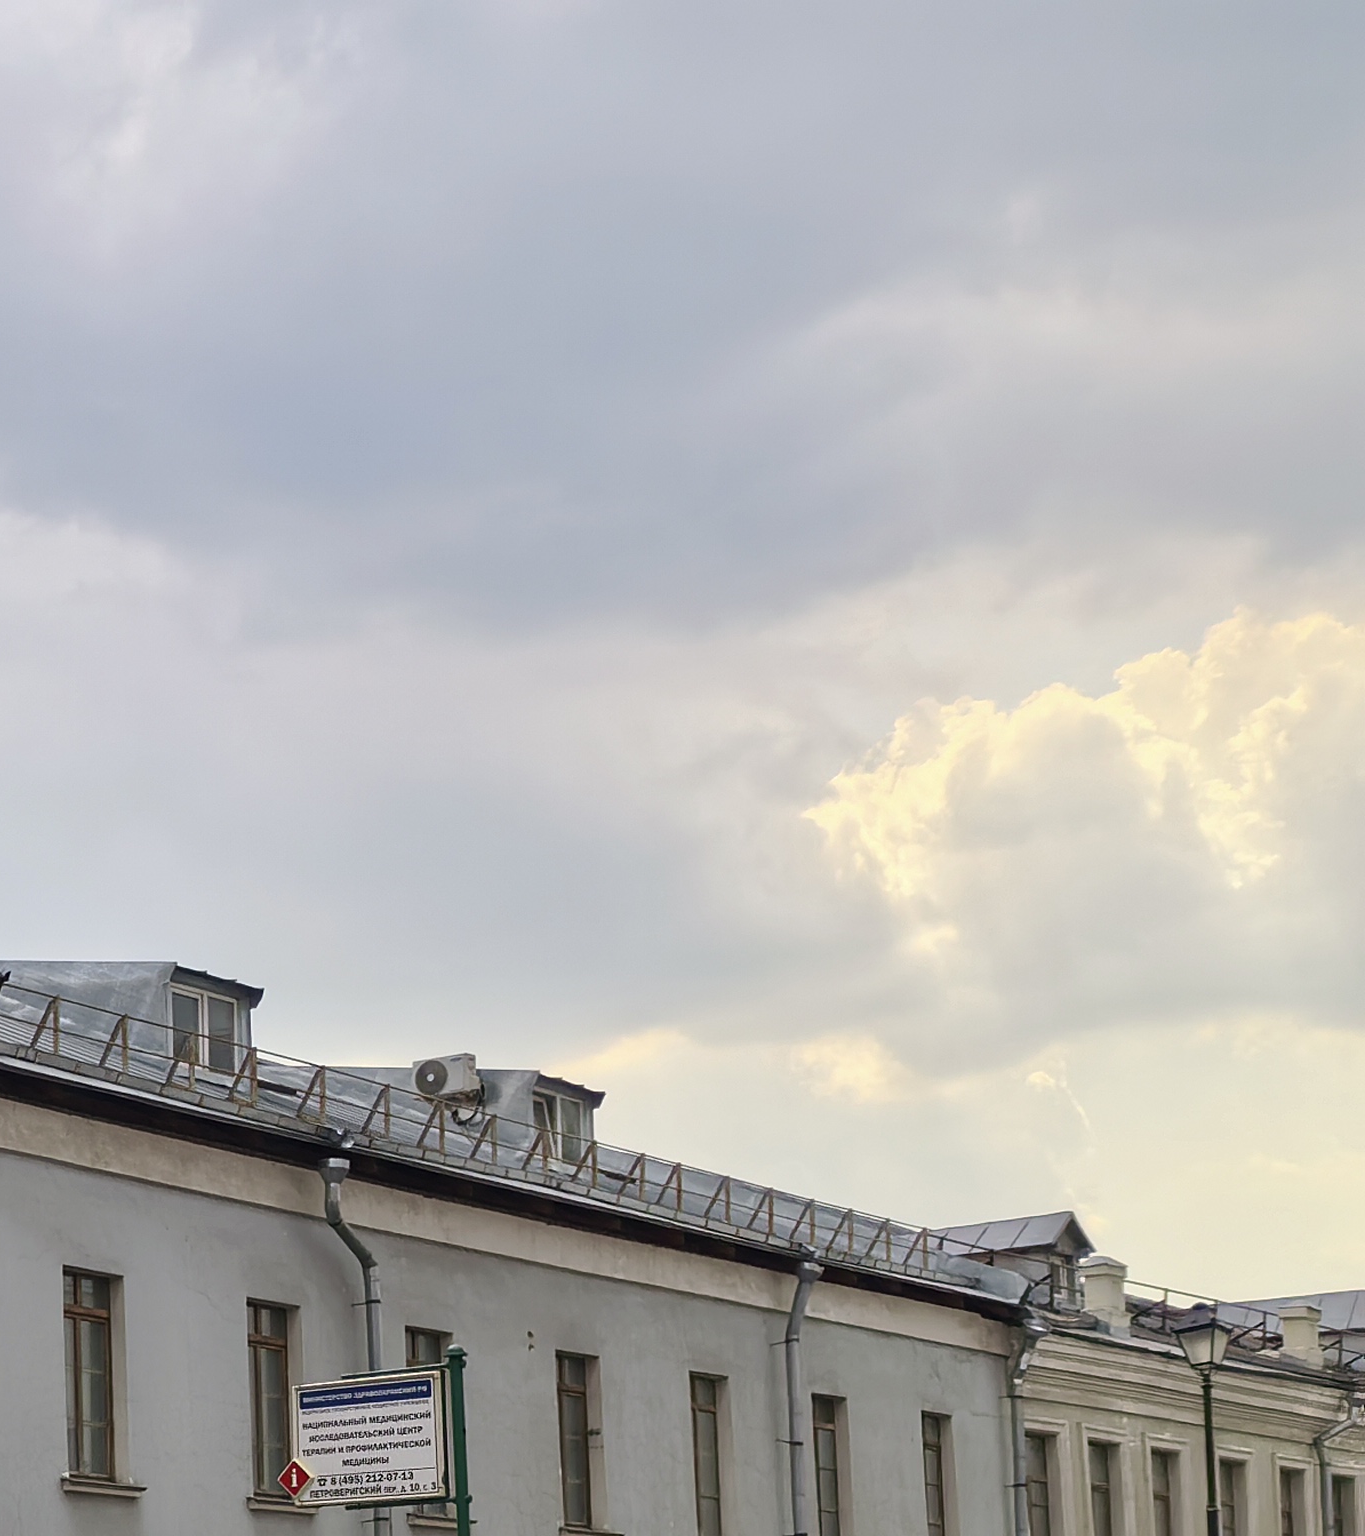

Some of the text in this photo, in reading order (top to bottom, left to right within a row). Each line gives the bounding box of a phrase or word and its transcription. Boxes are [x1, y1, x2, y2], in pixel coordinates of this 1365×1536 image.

[369, 1409, 432, 1424] МЕДИЦИНСКИЙ
[309, 1426, 423, 1443] ИССЛЕДОВАТЕЛЬСКИЙ ЦЕНТР
[302, 1439, 432, 1457] ТЕРАПИИ И ПРОФИЛАКТИЧЕСКОЙ
[342, 1456, 389, 1467] МЕДИЦИНЫ
[310, 1483, 382, 1498] ПЕТРОВЕРИГСКИЙ
